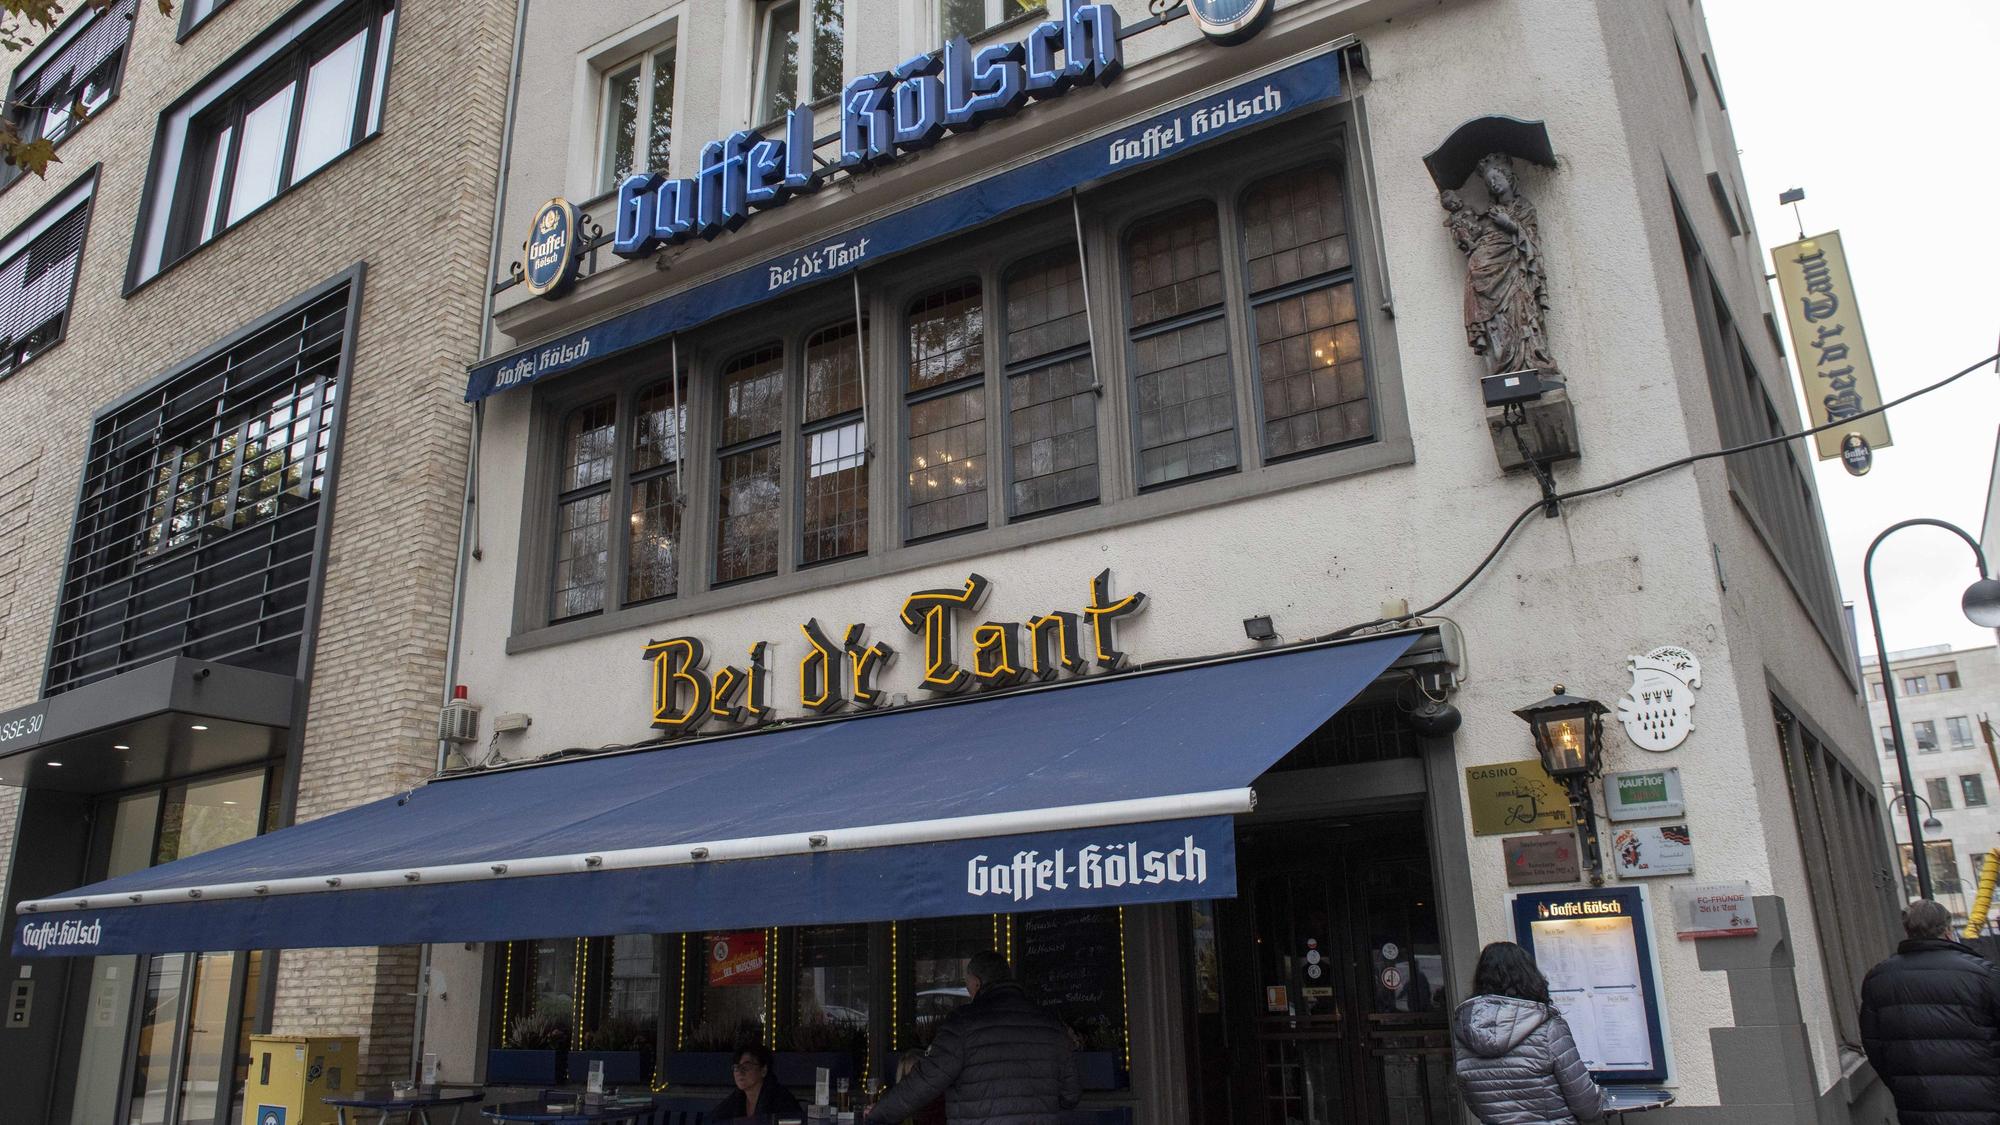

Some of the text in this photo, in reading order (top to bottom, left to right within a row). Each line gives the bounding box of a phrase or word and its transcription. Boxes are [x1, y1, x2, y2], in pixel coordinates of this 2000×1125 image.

[612, 0, 1123, 258] Gaffel Kölsch
[1109, 85, 1282, 165] Gaffel Kölsch
[530, 230, 565, 260] Gaffel
[535, 252, 558, 269] Kölsch
[822, 238, 870, 270] Tant
[1793, 248, 1839, 324] Tant
[496, 336, 590, 387] Gaffel Kölsch
[1818, 365, 1864, 423] Bei
[642, 636, 777, 732] Bei
[900, 567, 1150, 693] Tant
[0, 713, 44, 742] SSE 30
[1471, 767, 1518, 780] CASINO
[967, 835, 1207, 902] Gaffel-Kölsch
[1550, 900, 1621, 916] Gaffel Kölsch
[23, 918, 102, 951] Gaffel-Kölsch
